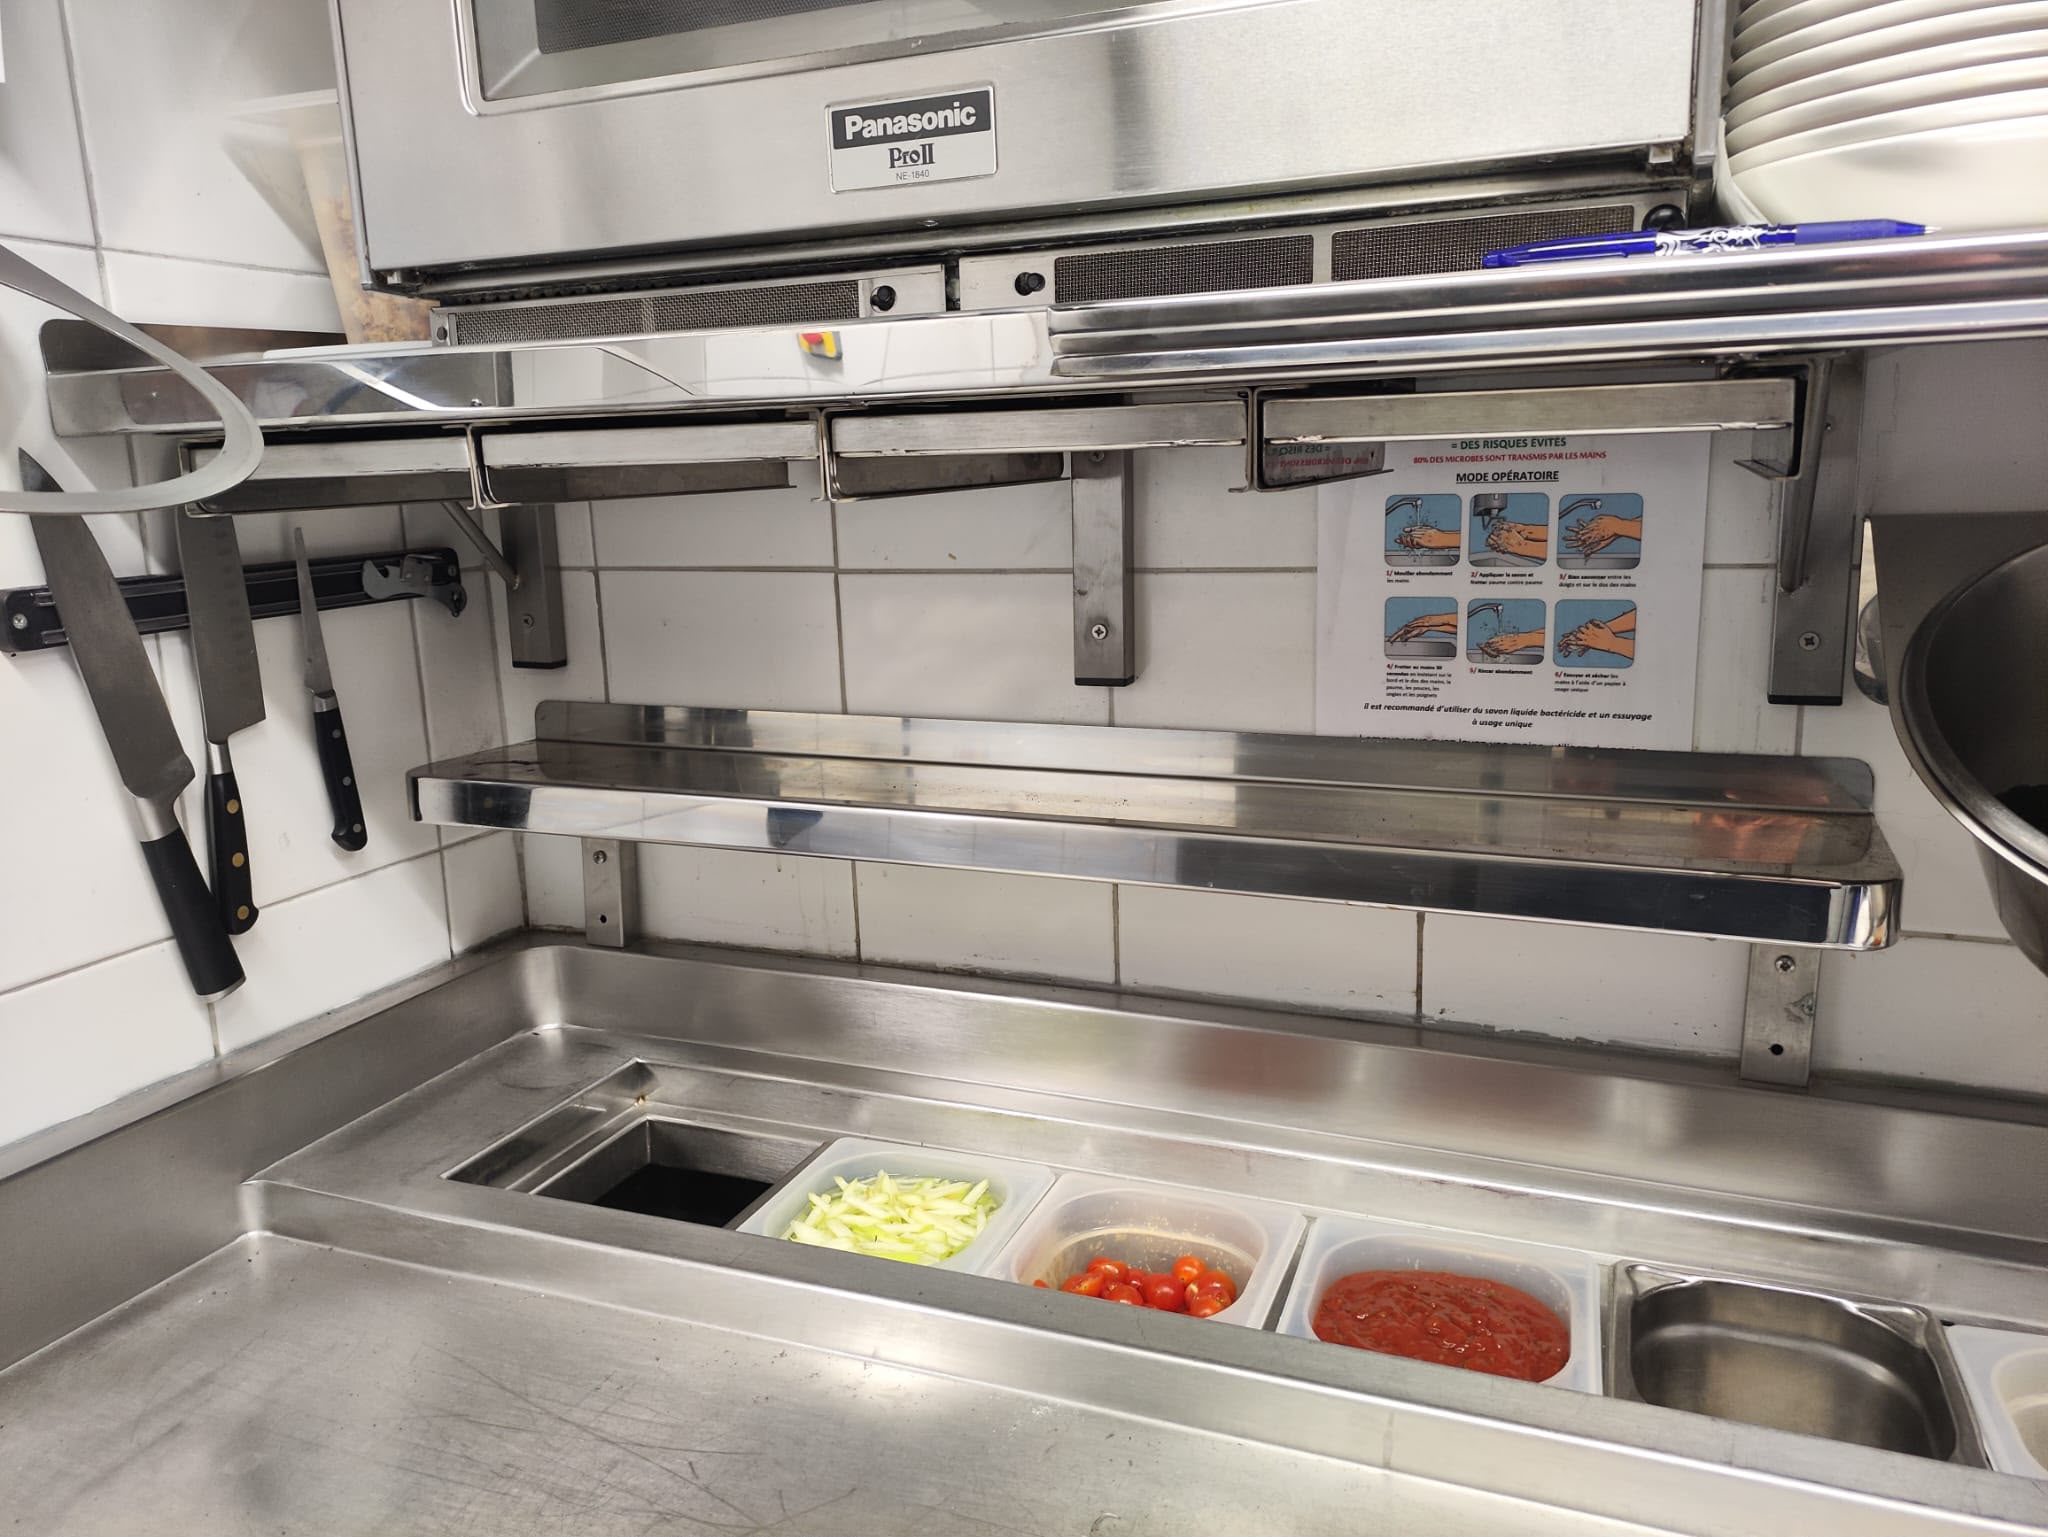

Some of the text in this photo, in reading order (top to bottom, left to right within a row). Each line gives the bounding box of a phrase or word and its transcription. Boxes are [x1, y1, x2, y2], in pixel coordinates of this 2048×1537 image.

[844, 102, 976, 140] Panasonic
[896, 170, 930, 181] NE-1840
[1460, 440, 1480, 450] DES
[1483, 438, 1528, 450] RISQUES
[1414, 456, 1428, 464] 80%
[1445, 454, 1484, 462] MICROBES
[1485, 454, 1506, 462] SONT
[1507, 453, 1546, 461] TRANSMIS
[1548, 452, 1563, 460] PAR
[1456, 470, 1559, 482] MODE OPÉRATOIRE
[1384, 704, 1434, 712] recommandé
[1436, 705, 1471, 713] d'utiliser
[1473, 706, 1482, 714] du
[1510, 708, 1538, 716] liquide
[1540, 709, 1586, 718] bactéricide
[1612, 713, 1652, 721] essuyage
[1505, 720, 1533, 728] unique
